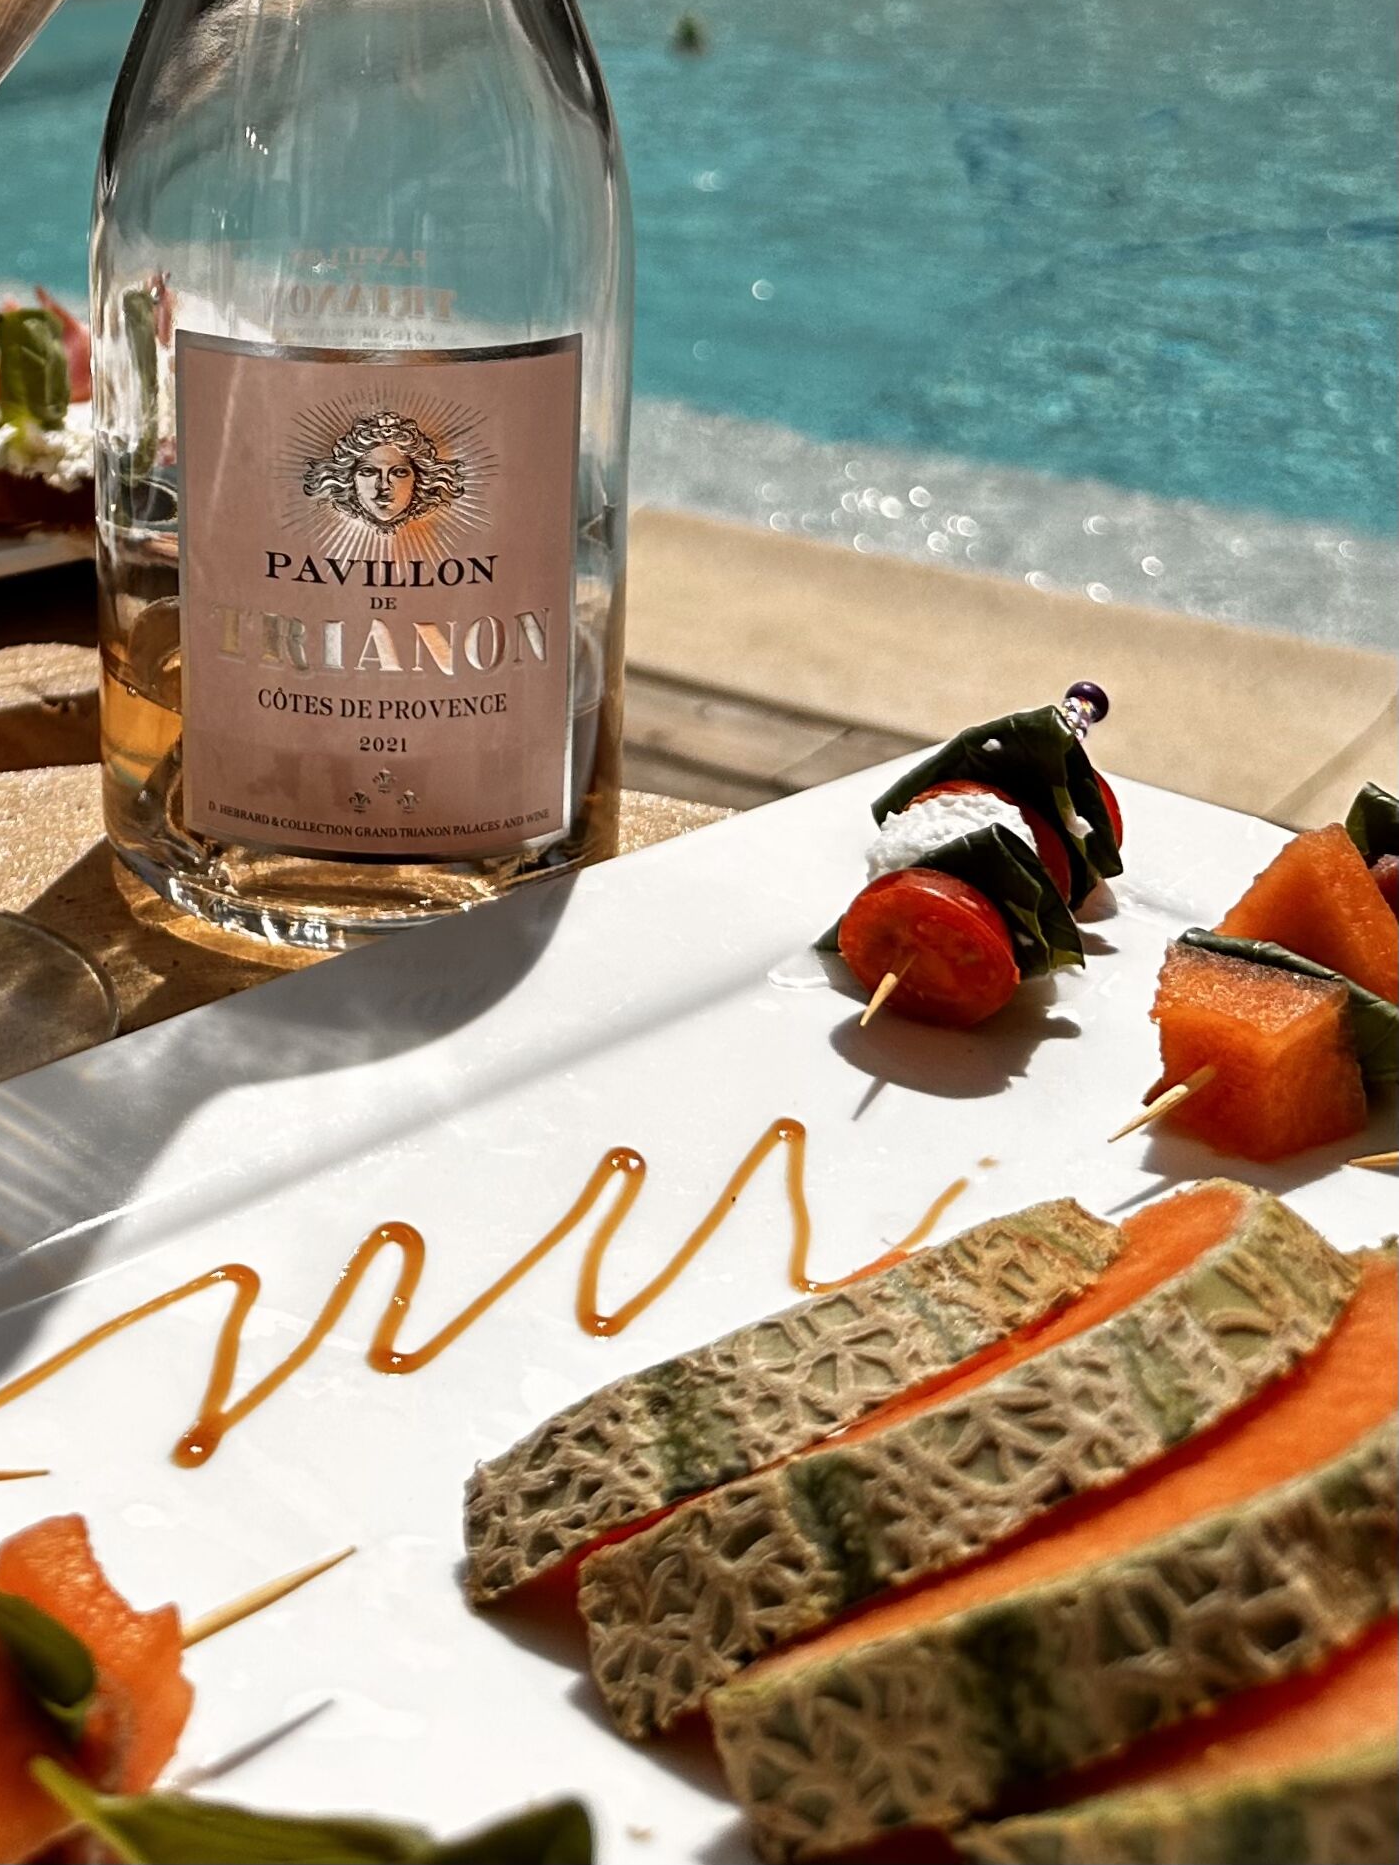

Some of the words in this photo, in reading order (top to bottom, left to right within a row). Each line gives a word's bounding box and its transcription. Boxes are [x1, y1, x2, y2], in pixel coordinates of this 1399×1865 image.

[264, 550, 499, 588] PAVILLON
[369, 596, 398, 611] DE
[208, 606, 551, 676] TRIANON
[258, 687, 333, 716] CÔTES
[340, 698, 372, 719] DE
[378, 693, 507, 720] PROVENCE
[359, 736, 407, 752] 2021
[280, 818, 353, 836] COLLECTION
[355, 826, 397, 838] GRAND
[399, 826, 451, 837] TRIANON
[453, 820, 501, 835] PALACES
[503, 815, 525, 830] AND
[525, 808, 550, 823] WINE
